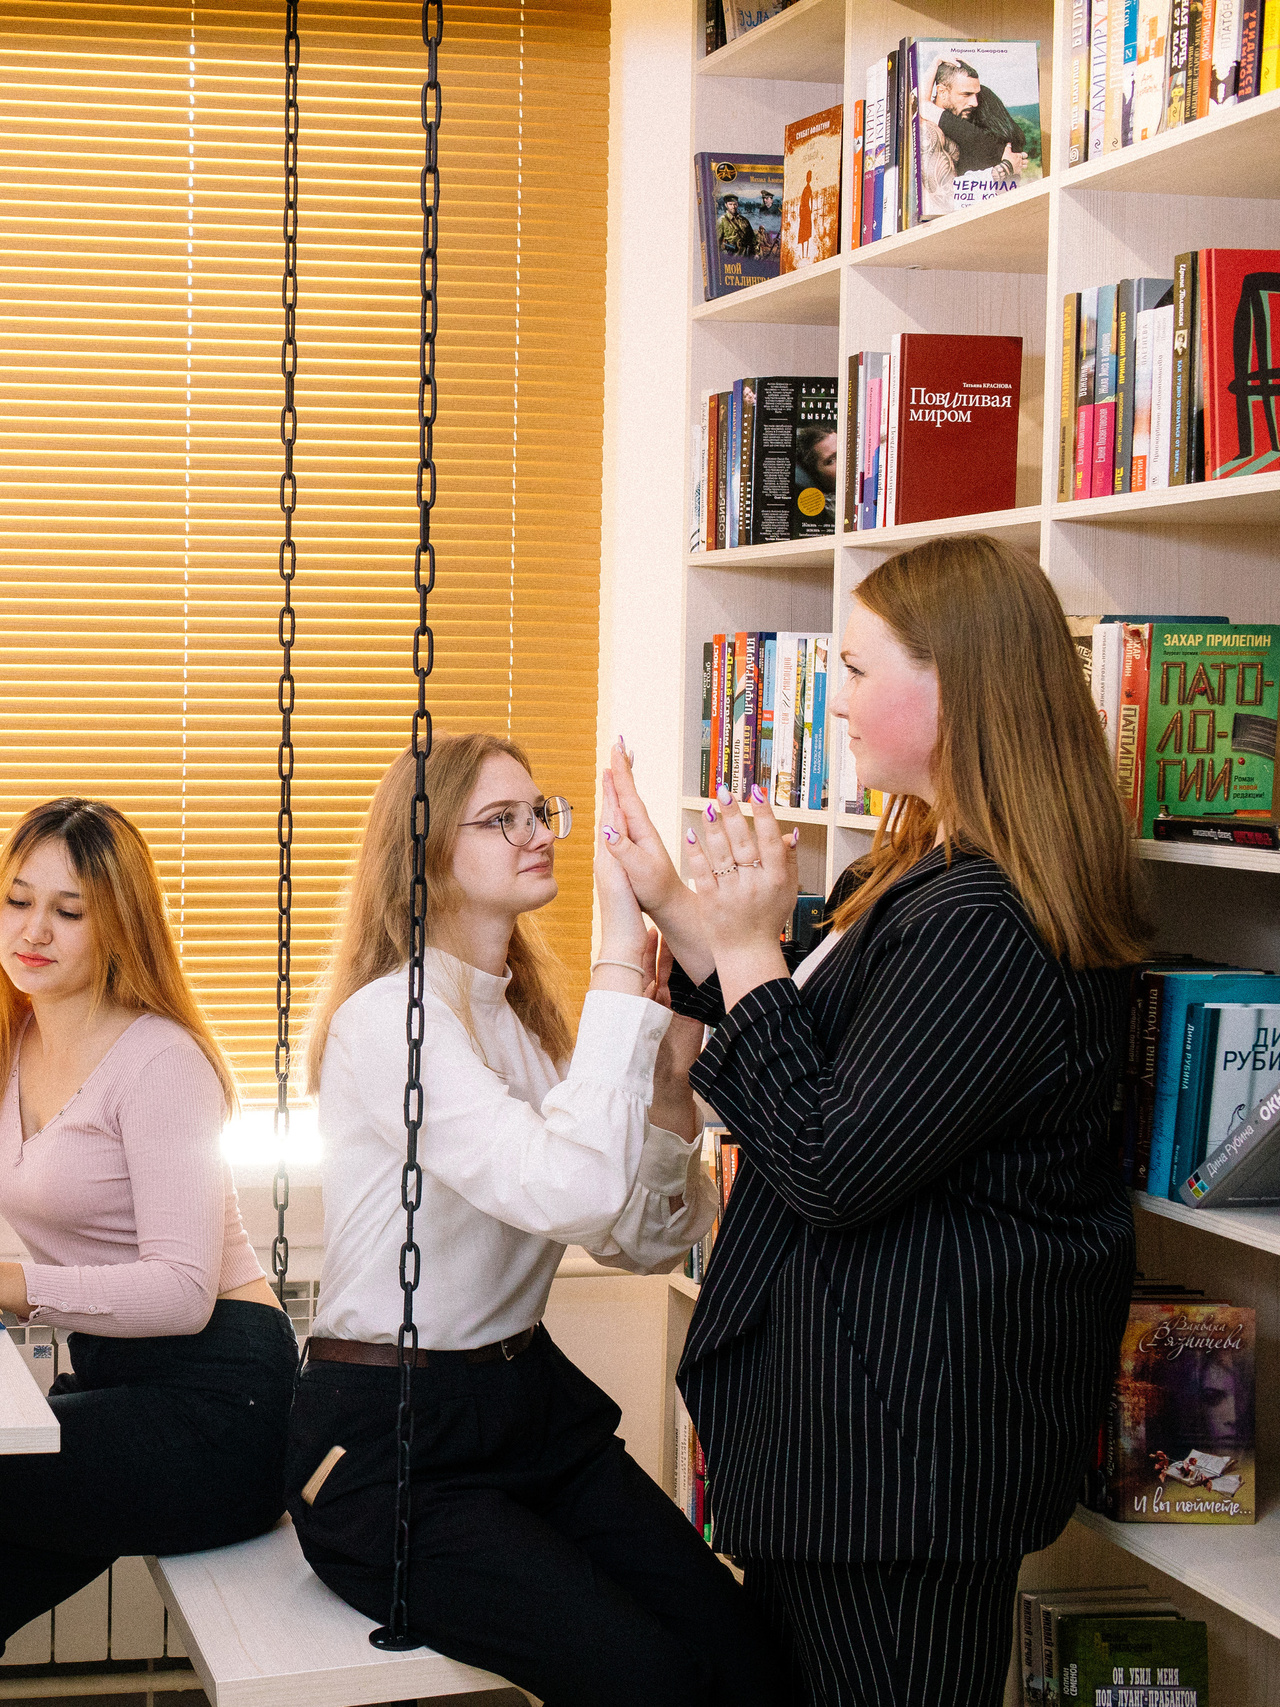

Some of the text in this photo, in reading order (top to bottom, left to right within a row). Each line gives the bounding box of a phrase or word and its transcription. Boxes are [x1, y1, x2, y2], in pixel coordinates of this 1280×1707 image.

[1201, 21, 1212, 61] ПИНСКИЙ
[1220, 0, 1234, 49] ПЛАТОВ
[1171, 31, 1180, 68] МАЯ
[1237, 12, 1250, 97] В ТЕМНОТЕ
[1244, 10, 1257, 96] УВИДИМСЯ
[953, 180, 1018, 191] ЧЕРНИЛА
[724, 262, 742, 275] МОЙ
[1118, 311, 1127, 385] ПРИНЦ ИНКОГНИТО
[982, 382, 1012, 390] КРАСНОВА
[909, 409, 972, 428] миром
[1163, 634, 1271, 648] ЗАХАР ПРИЛЕПИН
[743, 637, 756, 715] ОРФОГРАФИЯ
[1159, 661, 1274, 706] ПАТО-
[1156, 709, 1229, 755] ЛО-
[732, 738, 741, 794] ИСТРЕБИТЕЛЬ
[1156, 757, 1234, 803] ГИИ
[1181, 1023, 1196, 1090] Дина РУБИНА
[1206, 1142, 1228, 1178] Дина
[1225, 1124, 1255, 1156] Рубина
[1134, 1495, 1148, 1513] И
[1152, 1486, 1171, 1513] вы
[1069, 1662, 1078, 1697] СЕМЕНОВ
[1112, 1667, 1180, 1686] ОН УБИЛ МЕНЯ
[1095, 1689, 1198, 1707] ПОД ЛУАНГ-ПРАБАНГОМ
